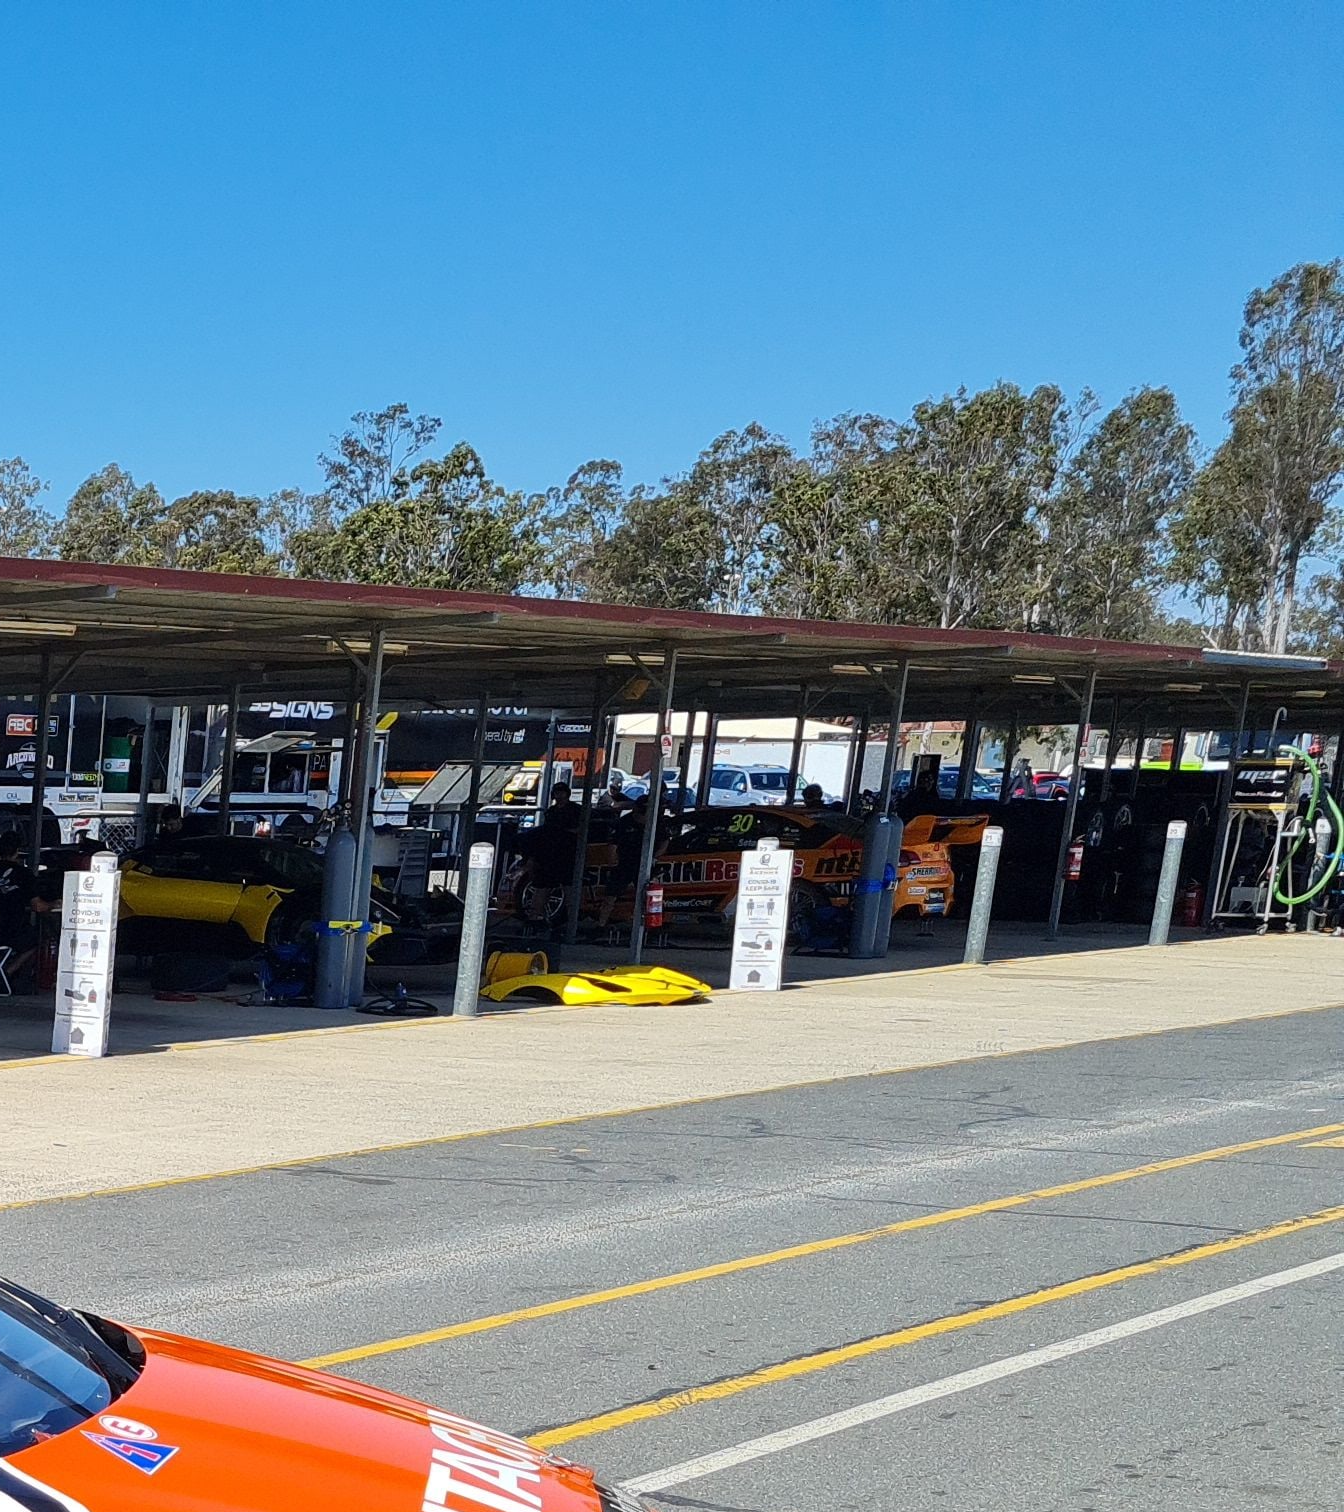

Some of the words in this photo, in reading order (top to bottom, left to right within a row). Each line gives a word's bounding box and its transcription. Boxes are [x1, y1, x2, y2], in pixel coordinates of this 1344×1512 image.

[729, 814, 754, 832] 30
[72, 909, 101, 917] COVID-19
[69, 917, 85, 925] KEEP
[86, 918, 104, 926] SAFE
